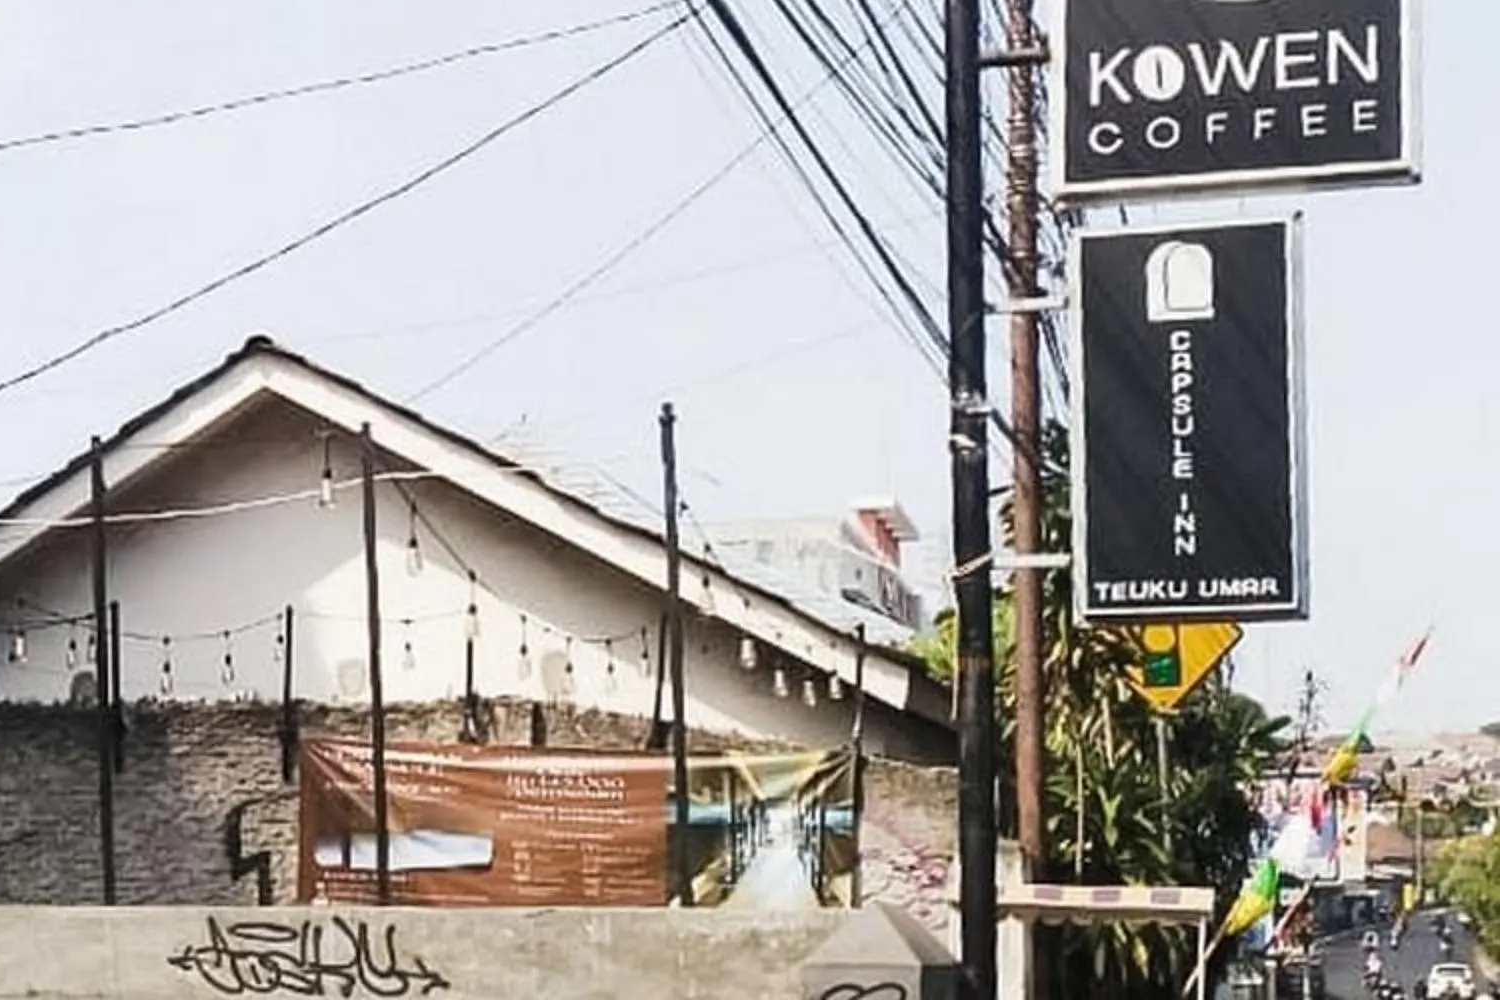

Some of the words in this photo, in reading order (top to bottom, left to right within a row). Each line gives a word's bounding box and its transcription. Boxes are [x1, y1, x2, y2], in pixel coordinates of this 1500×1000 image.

[1088, 25, 1380, 108] KOWEN
[1088, 100, 1379, 155] COFFEE
[1169, 331, 1195, 479] CAPSULE
[1174, 493, 1197, 556] INN
[1094, 580, 1188, 601] TEUKU
[1199, 577, 1280, 598] UMAR
